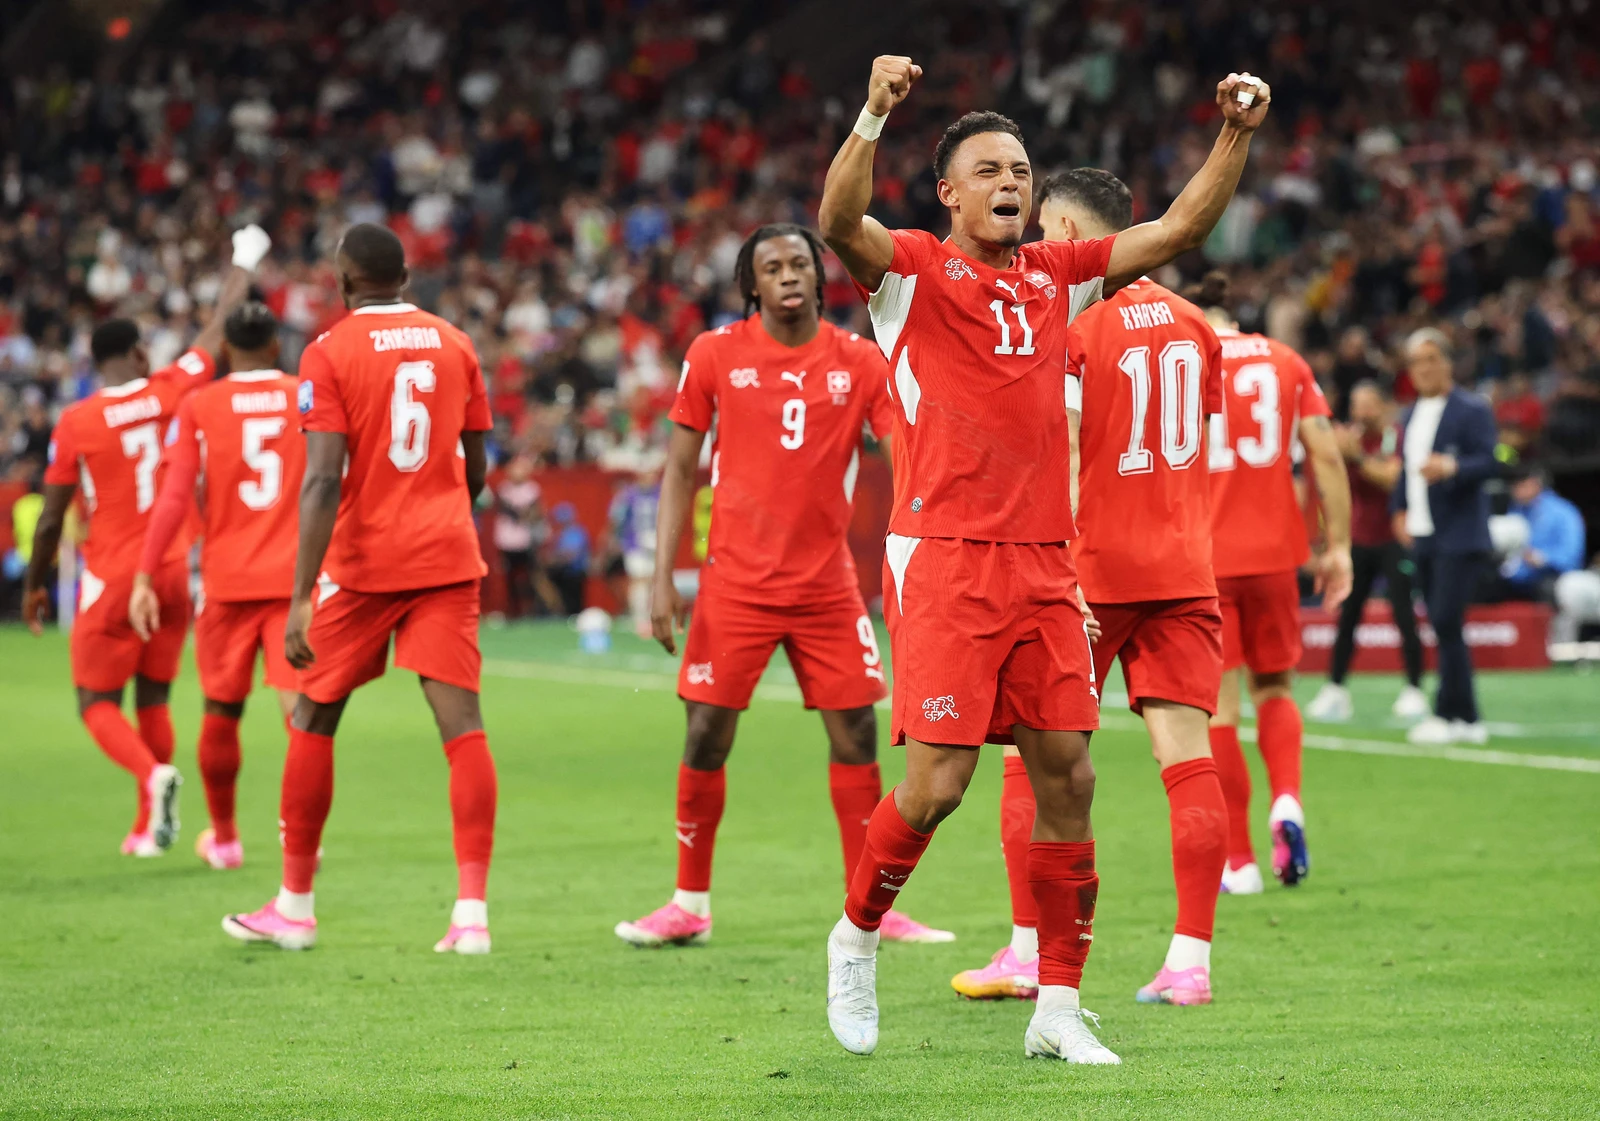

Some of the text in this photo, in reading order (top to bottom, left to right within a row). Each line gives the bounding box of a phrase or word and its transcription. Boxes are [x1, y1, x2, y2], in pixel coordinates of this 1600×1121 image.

[989, 299, 1036, 355] 11
[1118, 301, 1175, 330] XHAKA
[388, 360, 437, 472] 6
[780, 398, 807, 450] 9
[1118, 340, 1202, 476] 10
[120, 420, 163, 514] 7
[238, 416, 287, 511] 5
[856, 614, 881, 667] 9
